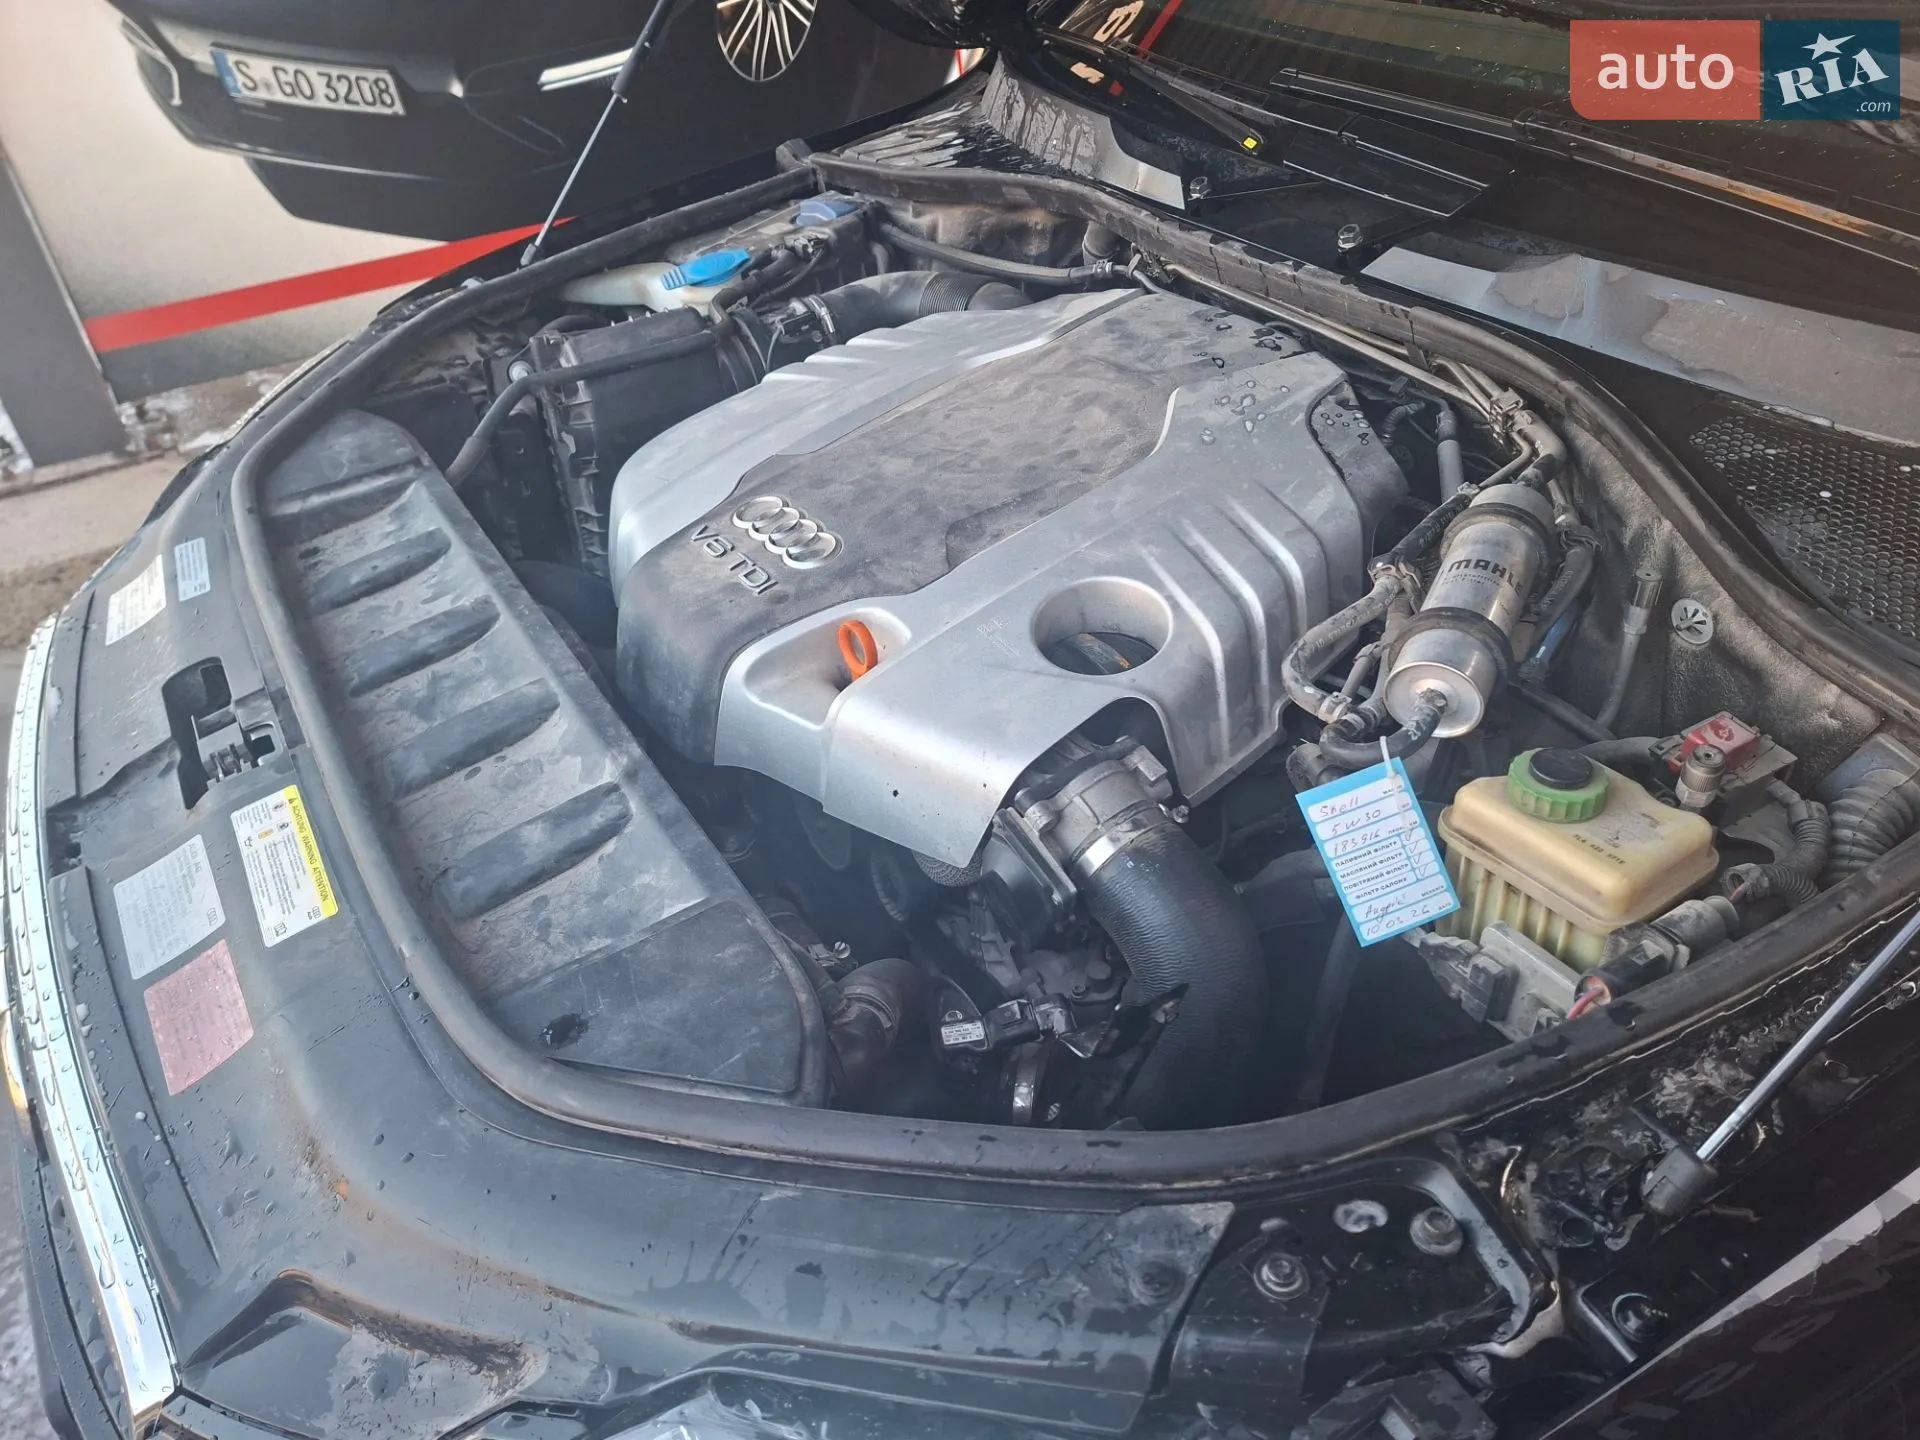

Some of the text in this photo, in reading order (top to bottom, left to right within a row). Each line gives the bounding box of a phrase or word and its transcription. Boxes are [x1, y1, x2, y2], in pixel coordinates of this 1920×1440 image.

[234, 60, 257, 92] S
[317, 72, 395, 108] 3208
[691, 525, 780, 595] V6 TDI
[1448, 559, 1523, 597] MAHLE
[292, 805, 329, 902] ACHTUNG WARNING ATTENTION
[1335, 841, 1398, 867] ПАЛИВНИЙ ФІЛЬТР
[1379, 852, 1403, 865] ФІЛЬТР
[1385, 864, 1409, 877] ФІЛЬТР
[1355, 887, 1380, 900] ФІЛЬТР
